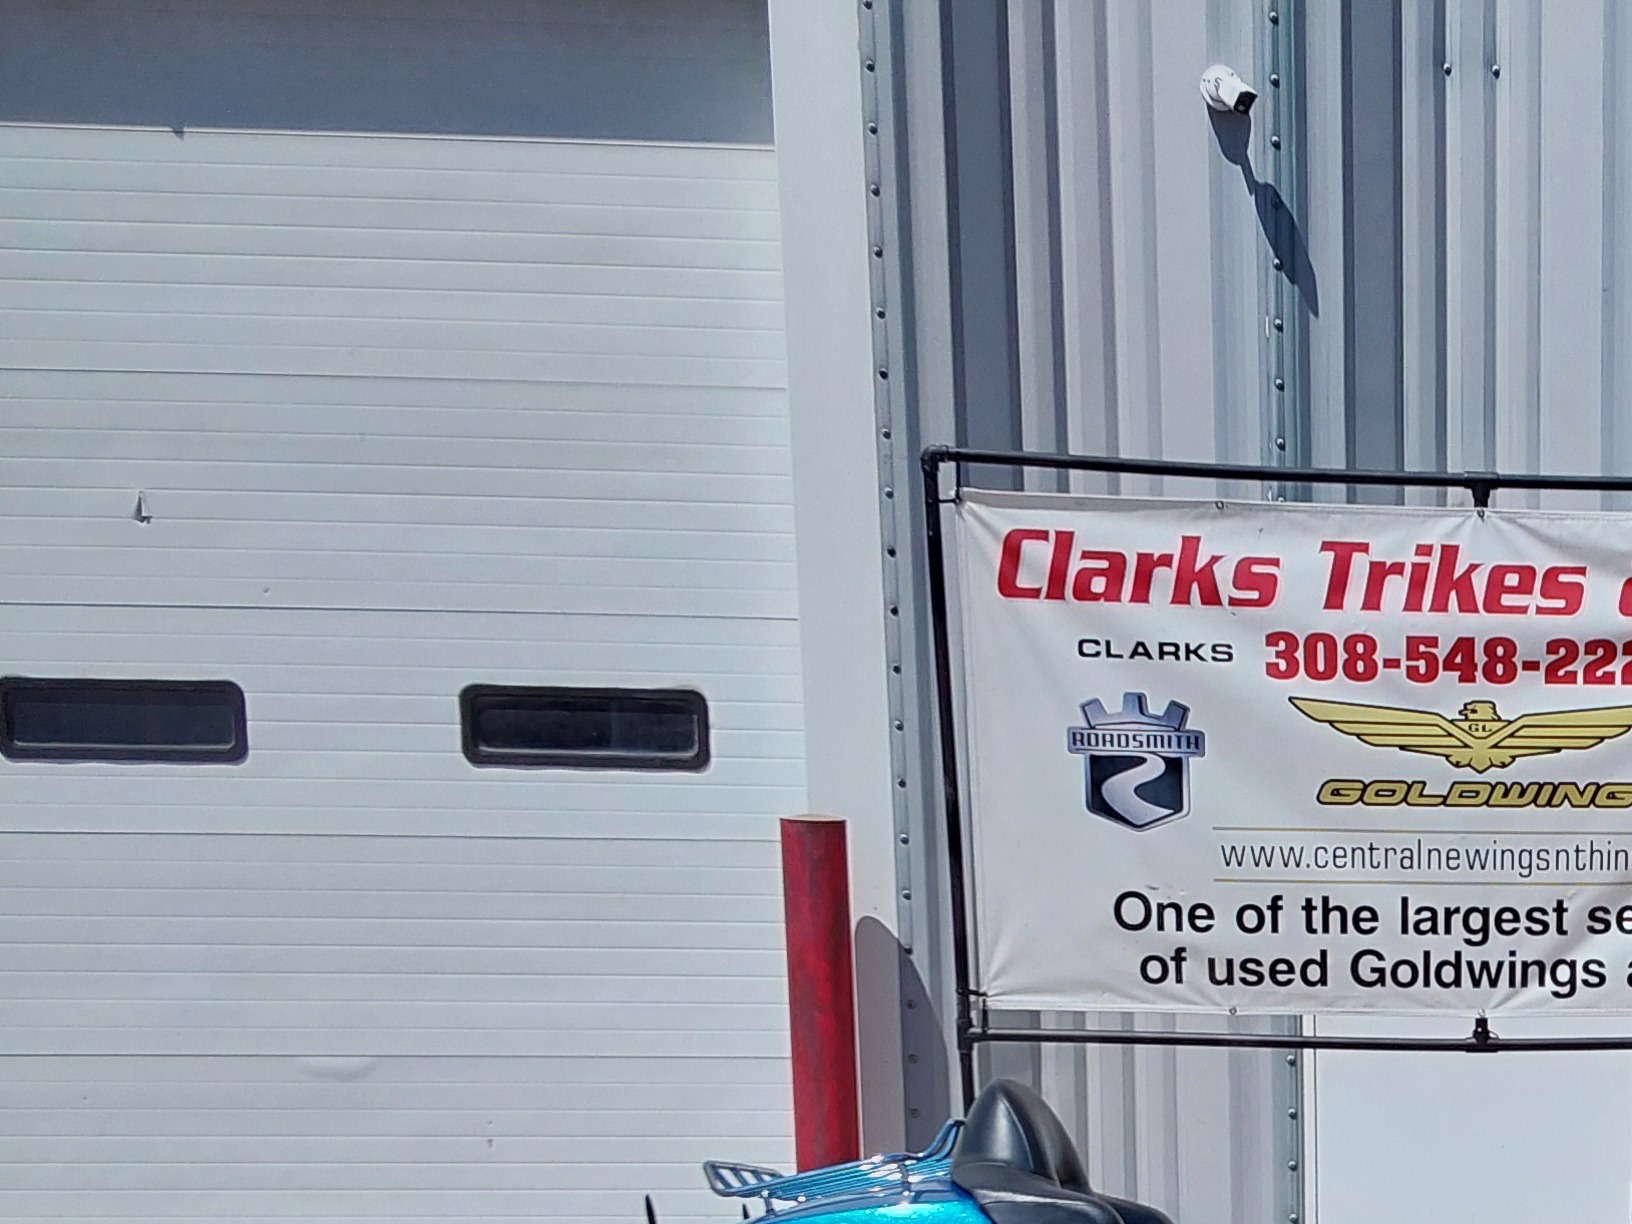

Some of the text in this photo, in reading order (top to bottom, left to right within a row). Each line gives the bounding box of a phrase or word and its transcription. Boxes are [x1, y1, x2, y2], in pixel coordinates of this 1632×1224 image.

[998, 529, 1281, 609] Clarks
[1320, 541, 1587, 617] Trikes
[1077, 638, 1234, 663] CLARKS
[1071, 731, 1201, 751] ROADSMITH
[1468, 723, 1493, 733] GL
[1113, 890, 1215, 933] One
[1235, 895, 1284, 934] of
[1301, 895, 1379, 935] the
[1401, 896, 1569, 947] largest
[1140, 946, 1187, 985] of
[1207, 949, 1328, 987] used
[1350, 948, 1607, 999] Goldwings
